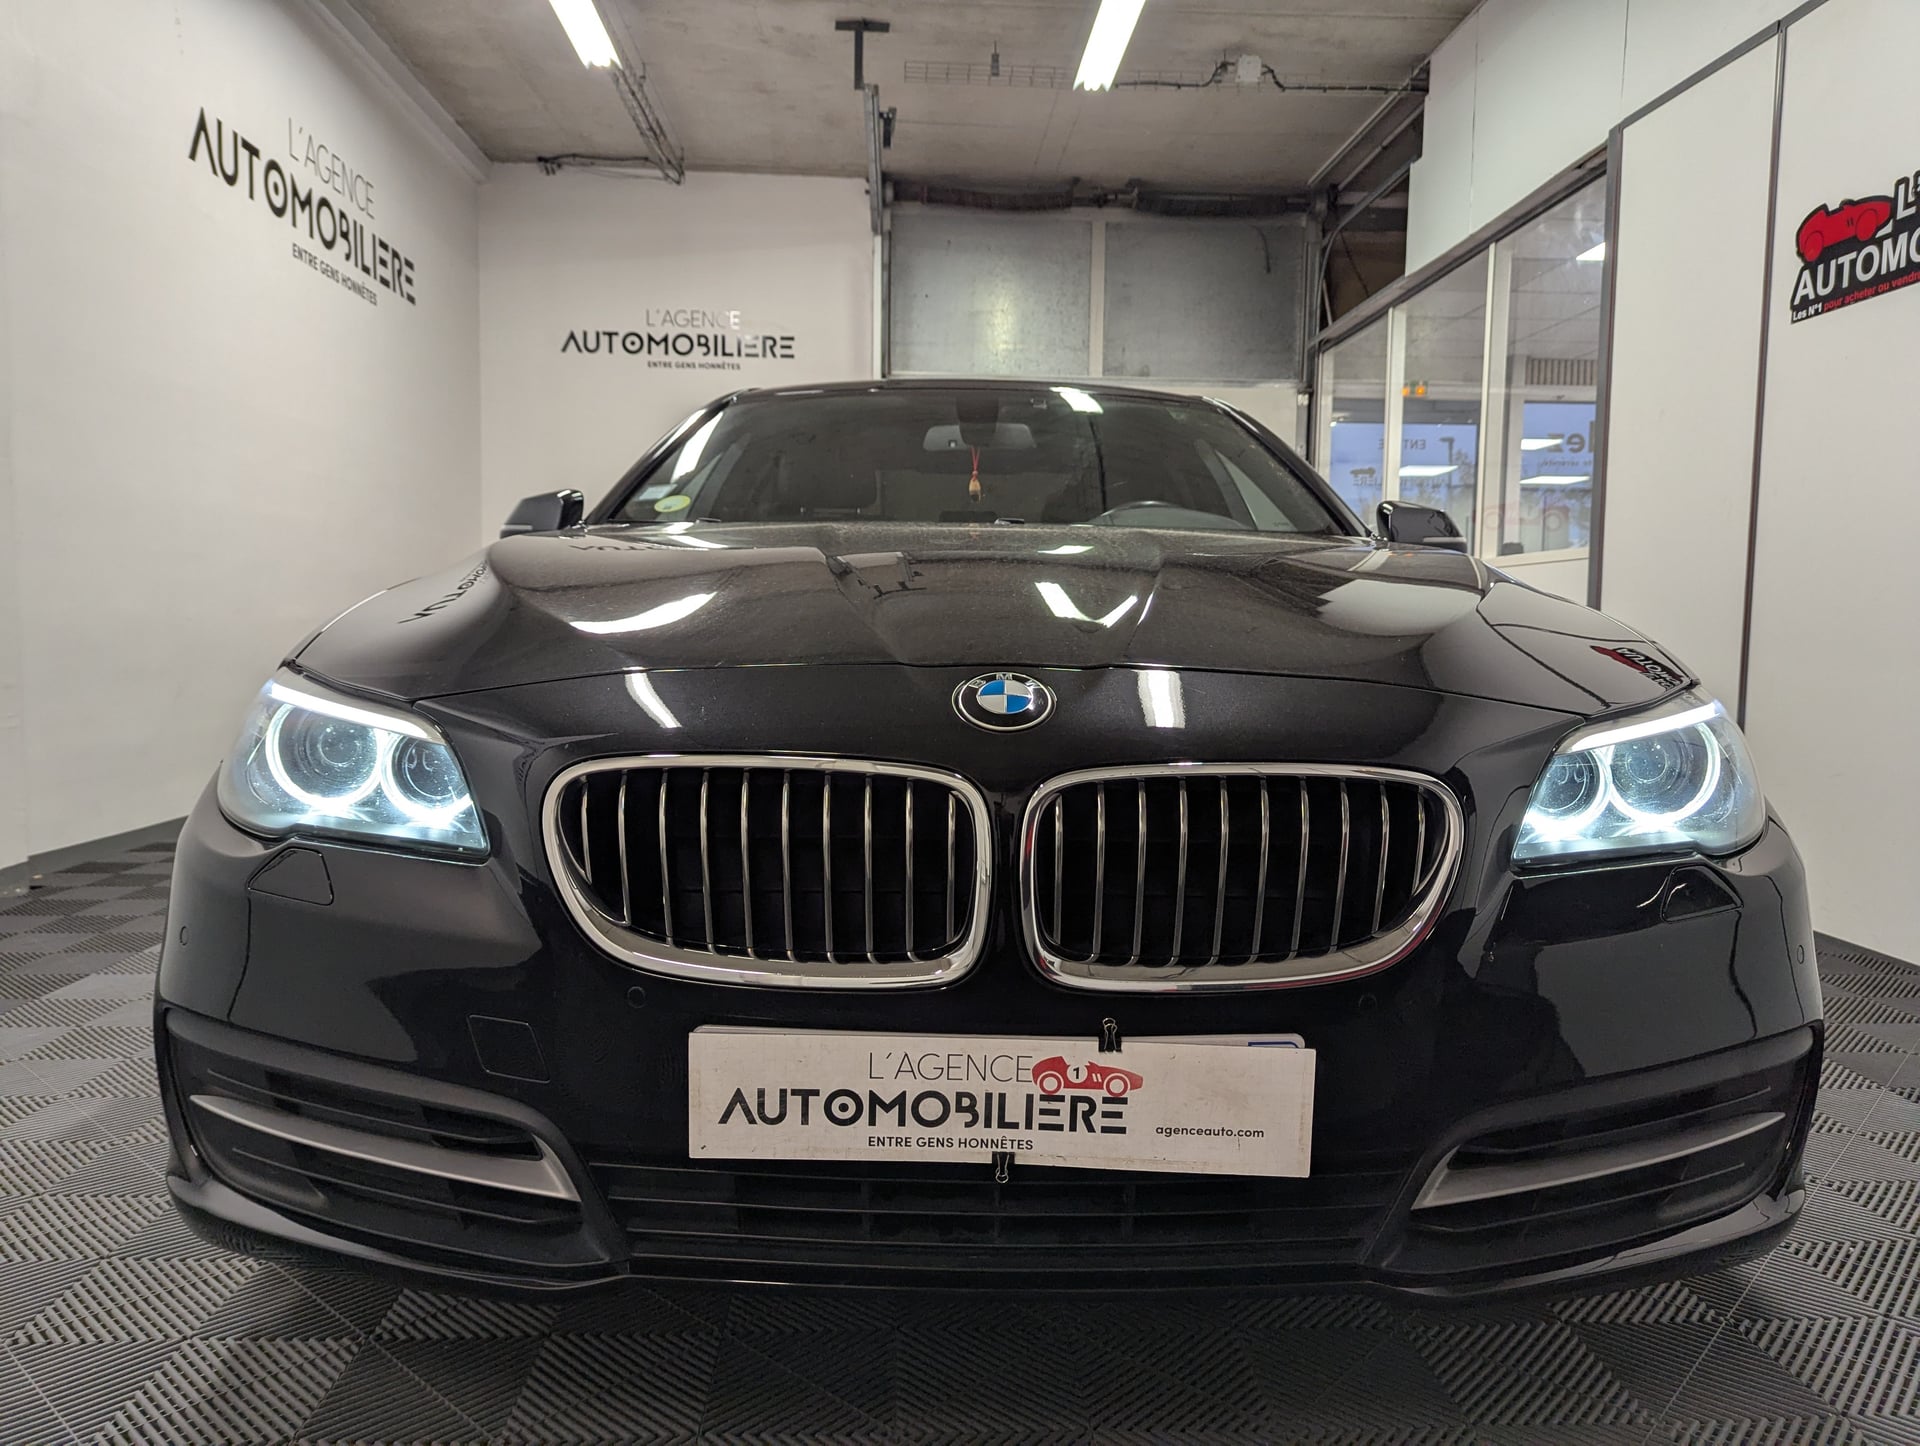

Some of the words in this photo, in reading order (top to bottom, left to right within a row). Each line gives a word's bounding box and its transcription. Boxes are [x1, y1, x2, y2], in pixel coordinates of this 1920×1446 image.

[289, 117, 375, 220] L'AGENCE
[188, 106, 416, 306] AUTOMOBILIERE
[293, 242, 319, 271] ENTRE
[320, 260, 340, 284] GENS
[1793, 309, 1807, 321] Les
[1823, 297, 1843, 312] pour
[1844, 286, 1877, 304] acheter
[1878, 282, 1890, 292] ou
[646, 309, 741, 330] L'AGENCE
[561, 330, 795, 359] AUTOMOBILIERE
[648, 360, 672, 369] ENTRE
[675, 361, 696, 370] GENS
[869, 1052, 1033, 1083] L'AGENCE
[718, 1087, 1128, 1135] AUTOMOBILIERE
[868, 1136, 912, 1148] ENTRE
[916, 1136, 954, 1149] GENS
[958, 1135, 1033, 1151] HONNÊTES
[1155, 1124, 1264, 1139] agenceauto.com
